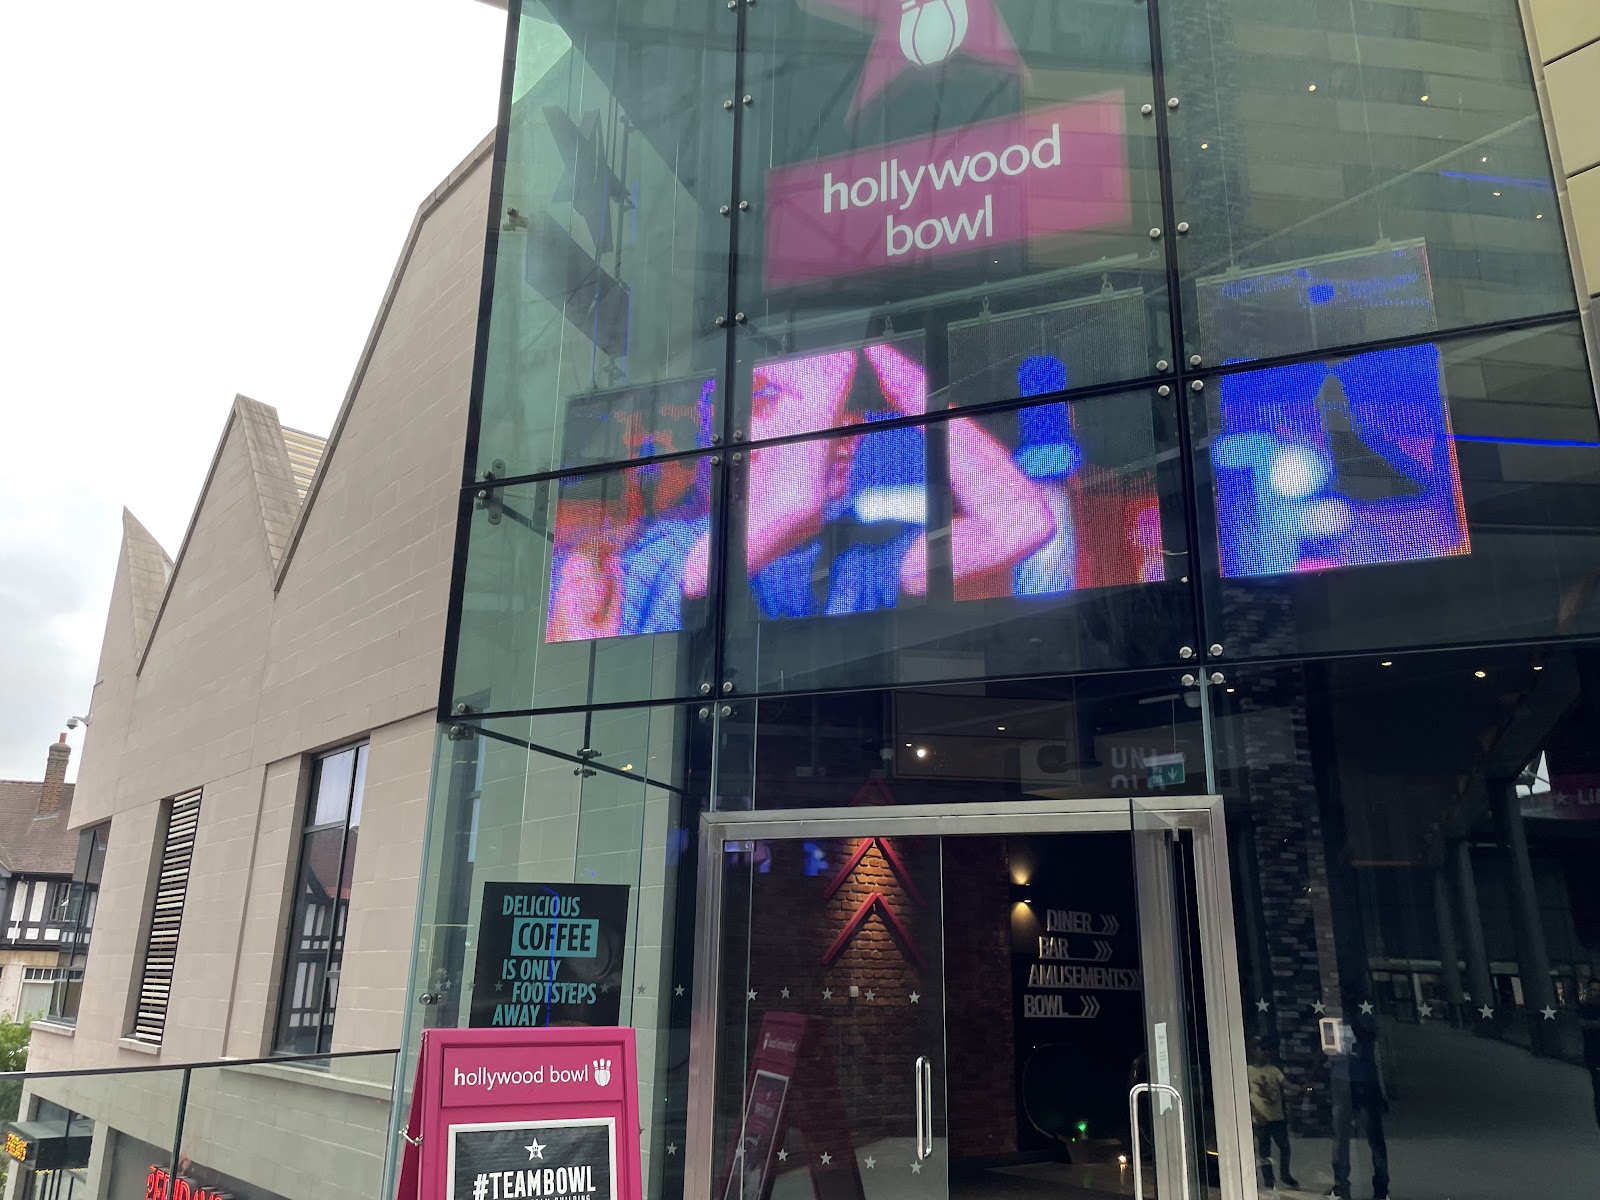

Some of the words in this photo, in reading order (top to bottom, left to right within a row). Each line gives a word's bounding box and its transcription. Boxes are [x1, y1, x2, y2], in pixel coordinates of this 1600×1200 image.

[823, 123, 1061, 211] hollywood
[886, 194, 993, 257] bowl
[502, 895, 581, 917] DELICIOUS
[1046, 909, 1093, 933] DINER
[518, 922, 592, 952] COFFEE
[1039, 936, 1069, 959] BAR
[502, 959, 517, 980] IS
[520, 959, 561, 981] ONLY
[1028, 964, 1130, 990] AMUSEMENTS
[512, 981, 597, 1005] FOOTSTEPS
[492, 1004, 541, 1026] AWAY
[1024, 994, 1070, 1017] BOWL
[453, 1065, 544, 1091] hollywood
[549, 1064, 589, 1083] bowl
[472, 1165, 596, 1200] #TEAMBOWL
